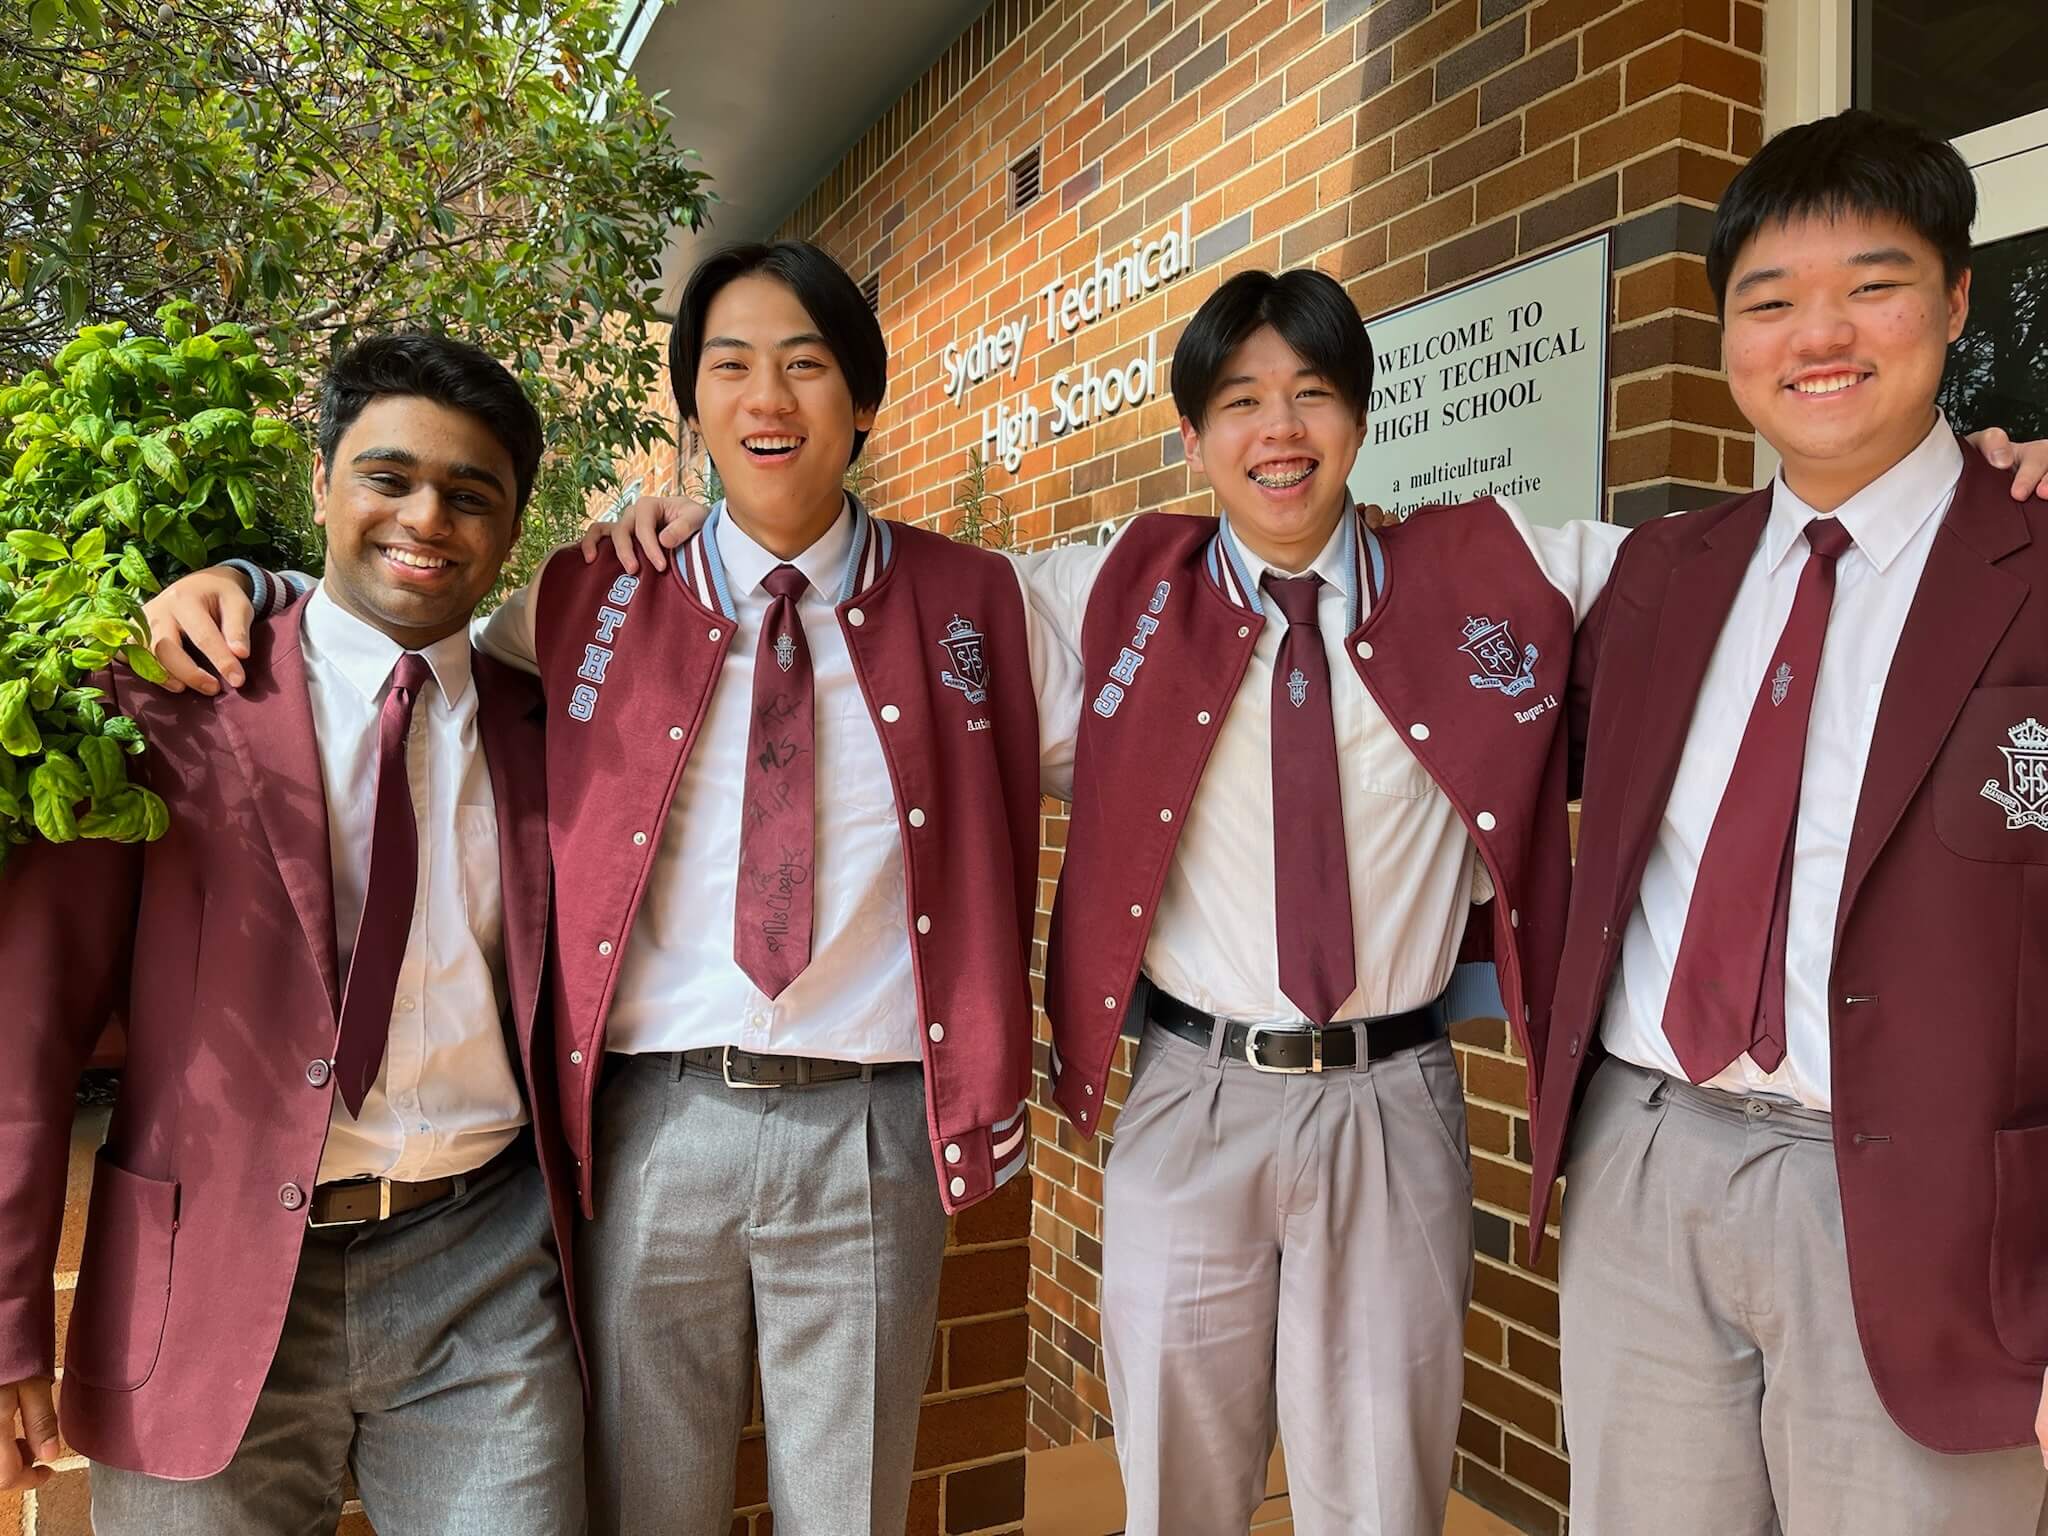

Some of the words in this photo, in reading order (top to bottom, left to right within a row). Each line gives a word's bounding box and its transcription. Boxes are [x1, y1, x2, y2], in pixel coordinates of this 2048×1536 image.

[943, 315, 1029, 408] Sydney
[1041, 202, 1191, 343] Technical
[1377, 317, 1494, 375] WELCOME
[1508, 301, 1543, 332] TO
[982, 392, 1040, 474] High
[1050, 332, 1158, 434] School
[1369, 375, 1427, 413] DNEY
[1440, 327, 1586, 391] TECHNICAL
[1374, 409, 1430, 445] HIGH
[1441, 378, 1543, 427] SCHOOL
[1392, 479, 1401, 493] a
[1410, 448, 1512, 489] multicultural
[568, 573, 640, 722] STHS
[1093, 581, 1171, 718] STHS
[1514, 702, 1545, 723] Roger
[1543, 694, 1558, 709] Li
